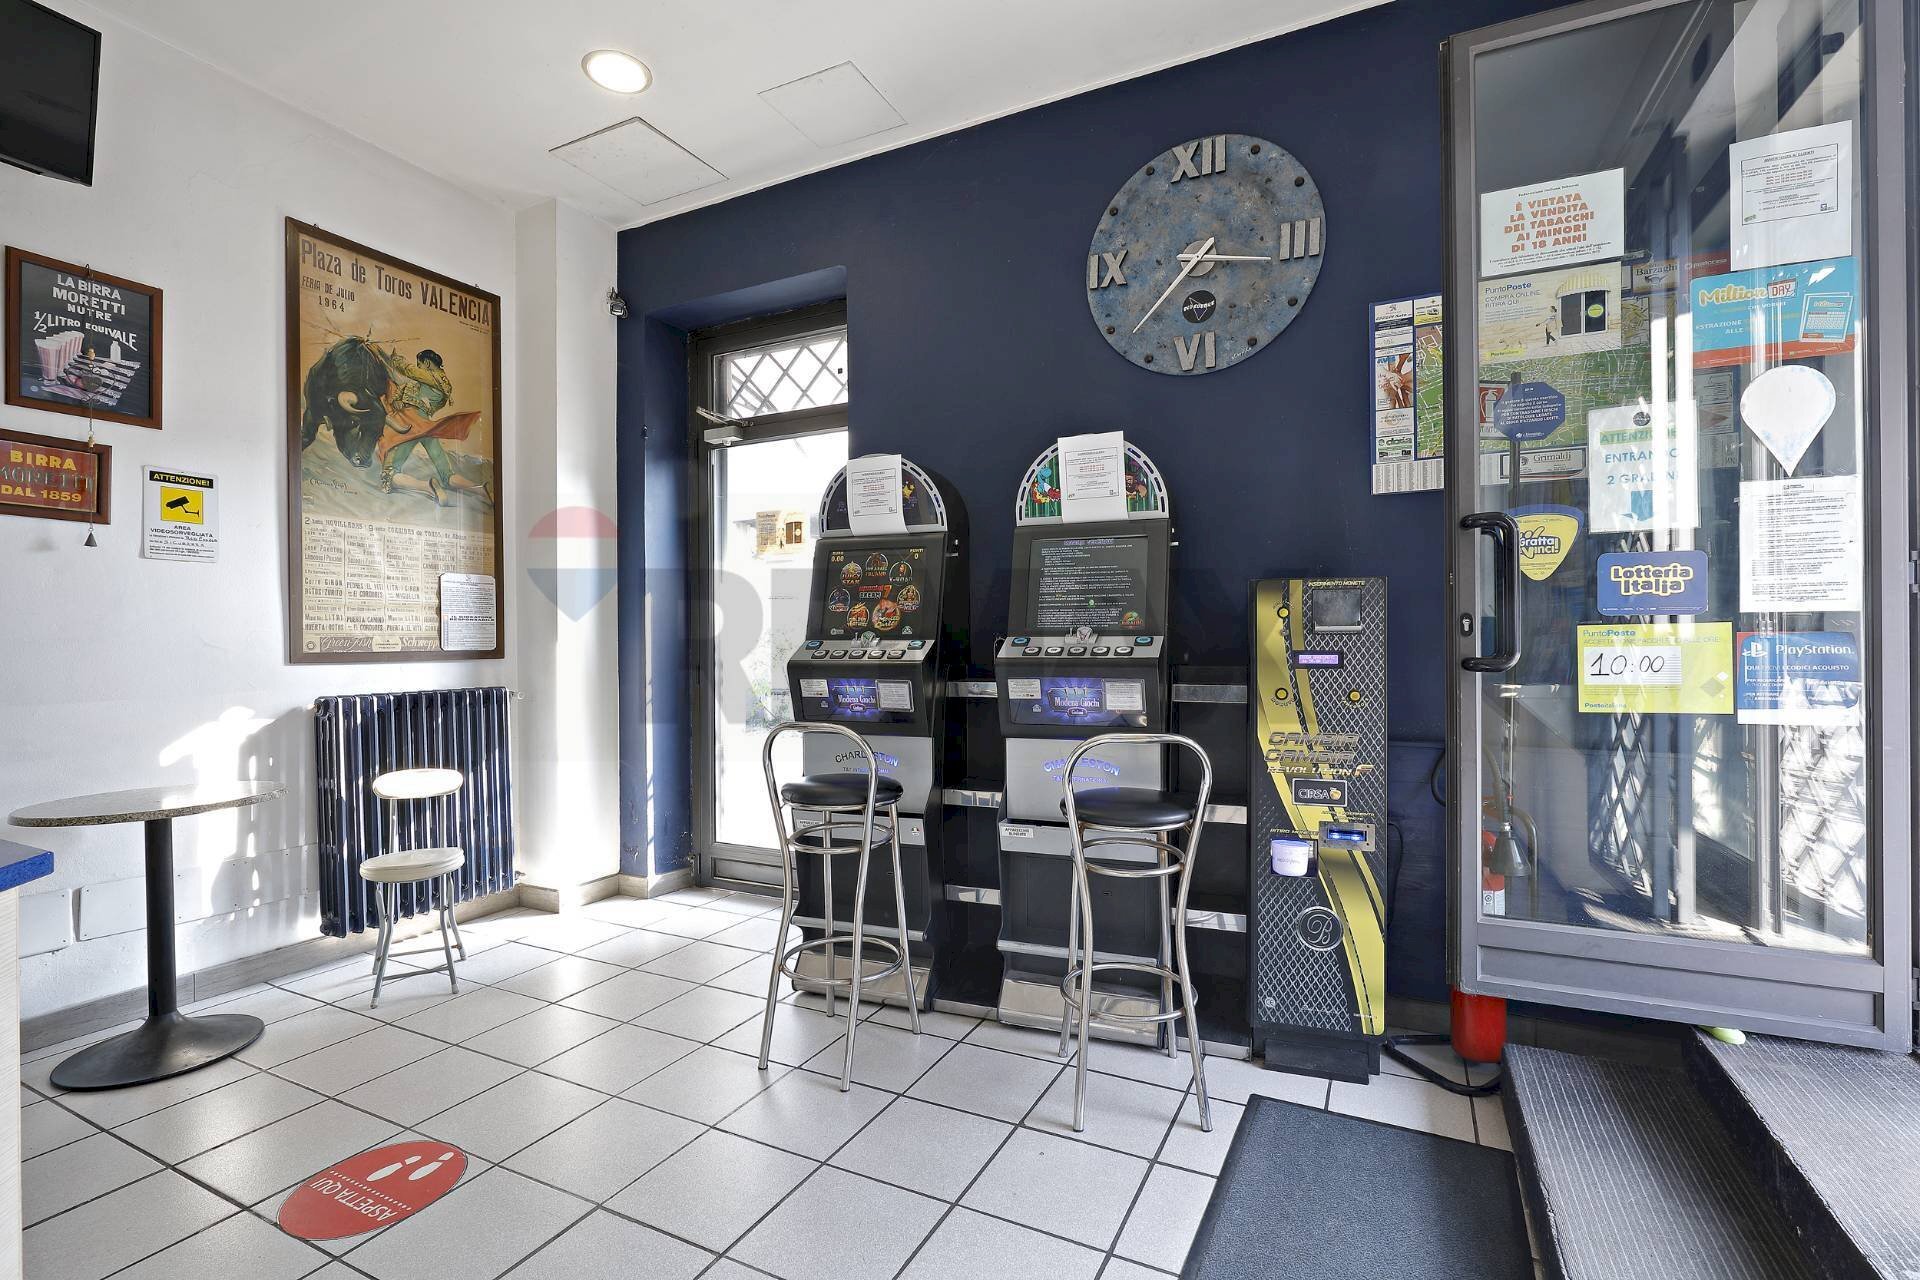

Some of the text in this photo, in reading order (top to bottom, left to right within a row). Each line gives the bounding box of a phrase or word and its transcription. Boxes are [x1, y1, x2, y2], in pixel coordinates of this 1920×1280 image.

[1171, 135, 1226, 183] XII
[1528, 192, 1582, 209] VIETATA
[1510, 202, 1588, 223] LA VENDITA
[1504, 211, 1595, 234] DEI TABACCHI
[1280, 217, 1321, 260] III
[1516, 223, 1587, 242] AI MINORI
[1511, 233, 1587, 253] DI 18 ANNI
[1089, 250, 1128, 290] IX
[57, 274, 122, 301] LA BIRRA
[301, 239, 490, 326] Plaza de Toros VALENCIA
[302, 276, 355, 301] FERIA DE JULIO
[1485, 282, 1532, 294] PuntoPoste
[1771, 284, 1791, 298] DAY
[52, 287, 126, 316] MORETTI
[318, 296, 345, 312] 1964
[1485, 289, 1541, 303] COMPRA ONLINE
[67, 303, 112, 322] NUTRE
[47, 313, 81, 328] LITRO
[85, 322, 138, 351] EQUIVALE
[1695, 319, 1743, 330] ESTRAZIONE
[1173, 330, 1216, 371] VI
[10, 450, 76, 471] BIRRA
[153, 473, 210, 487] ATTENZIONE!
[1607, 476, 1615, 484] 2
[1, 485, 82, 502] DAL 1859
[151, 528, 213, 538] VIDEOSORVEGLIATA
[1612, 564, 1692, 580] Lotteria
[1622, 579, 1683, 595] Italia
[1583, 629, 1636, 637] PuntoPoste
[1776, 645, 1851, 658] PlayStation
[1590, 653, 1665, 676] 10:00
[1054, 696, 1100, 707] Modena Giochi
[1268, 732, 1359, 747] CAMBIA
[835, 750, 899, 767] CHARLSTON
[1264, 749, 1356, 765] CAMBIA
[1298, 788, 1330, 800] CIRSA
[310, 1177, 398, 1221] ASPETTA QUI
